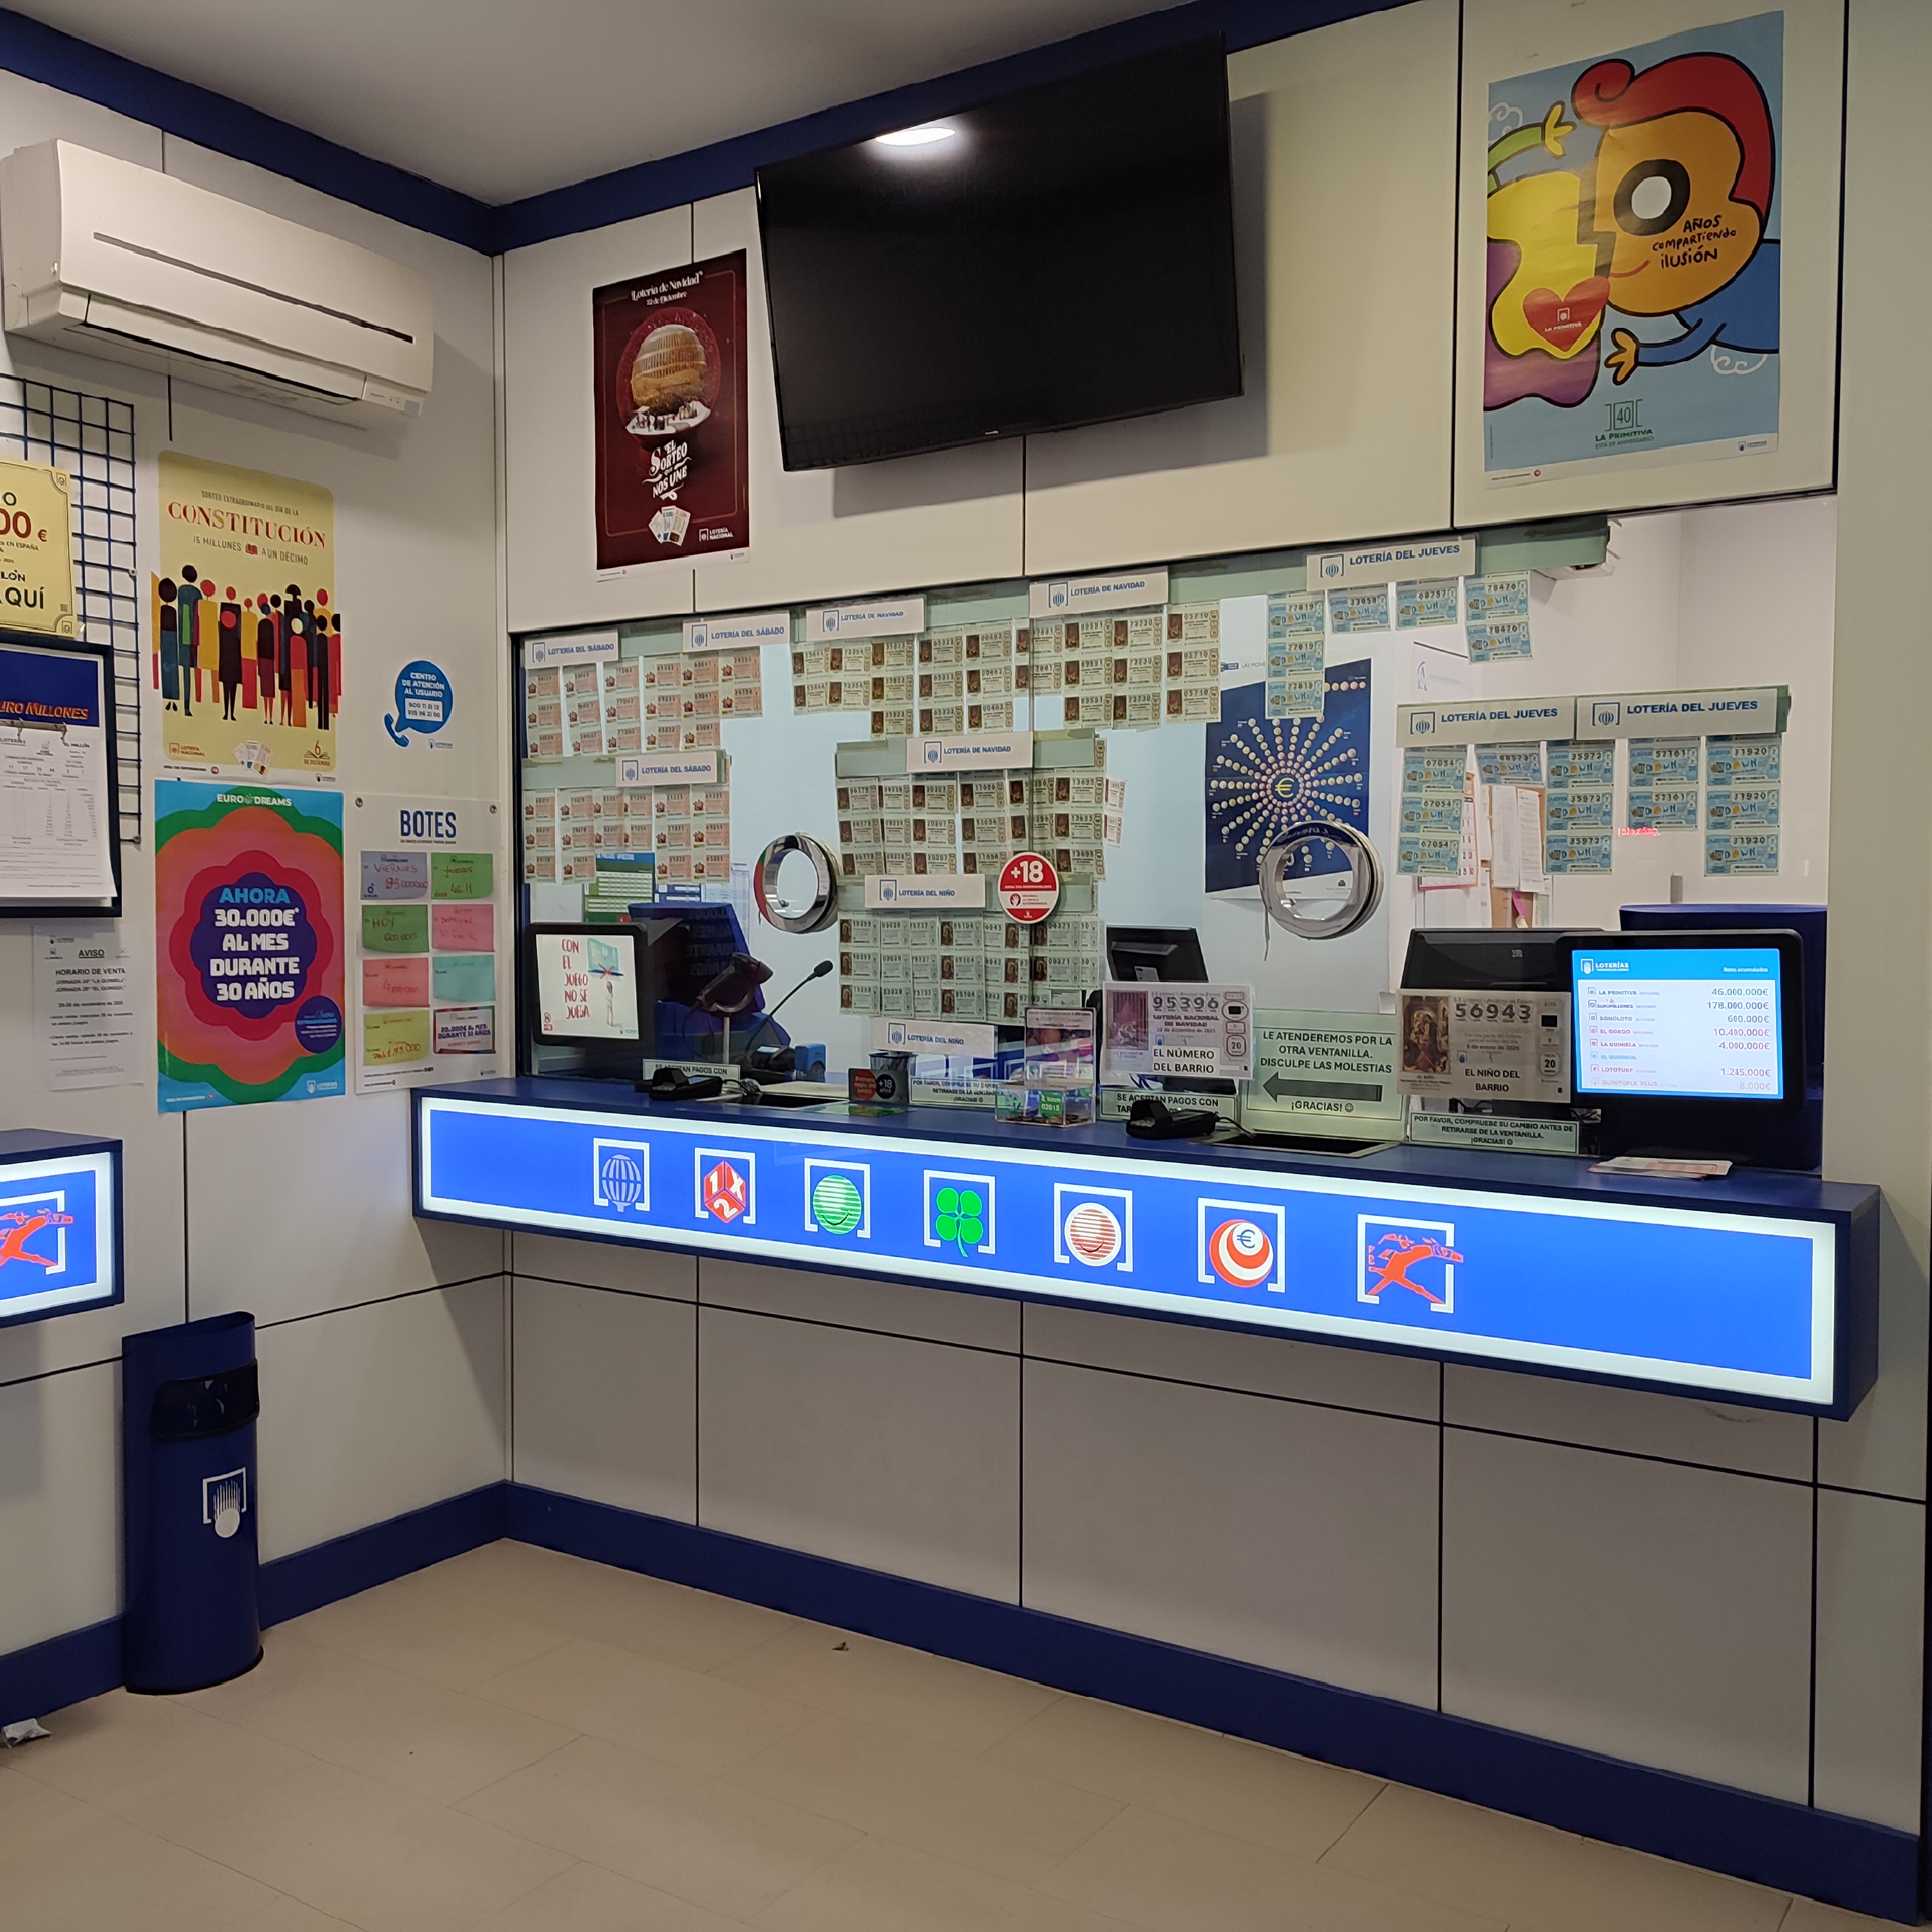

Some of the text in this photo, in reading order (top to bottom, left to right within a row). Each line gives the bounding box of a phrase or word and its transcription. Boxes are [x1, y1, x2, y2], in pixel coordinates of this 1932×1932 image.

[1616, 406, 1632, 424] 40
[1595, 428, 1654, 442] LA PRIMITIVA
[664, 440, 676, 453] EL
[649, 442, 688, 477] SORTEO
[653, 466, 688, 498] NOS UNE
[168, 502, 326, 548] CONSTITUCIÓN
[203, 537, 242, 551] MILLONES
[261, 547, 266, 556] A
[1349, 544, 1460, 565] LOTERÍA DEL JUEVES
[1070, 583, 1100, 596] LOTERÍA
[1113, 581, 1145, 591] NAVIDAD
[711, 629, 739, 639] LOTERÍA
[415, 688, 443, 697] USUARIO
[25, 701, 89, 720] MILLONES
[1627, 701, 1758, 714] LOTERÍA DEL JUEVES
[1441, 708, 1558, 723] LOTERÍA DEL JUEVES
[314, 740, 321, 755] 6
[943, 744, 971, 755] LOTERÍA
[982, 744, 1011, 753] NAVIDAD
[641, 765, 668, 774] LOTERÍA
[684, 764, 711, 772] SÁBADO
[216, 793, 292, 806] EURO DREAMS
[400, 810, 457, 838] BOTES
[1010, 860, 1043, 883] +18
[220, 887, 290, 904] AHORA
[898, 888, 923, 897] LOTERÍA
[938, 888, 955, 897] NIÑO
[223, 933, 289, 951] AL MES
[562, 939, 580, 953] CON
[79, 949, 105, 958] AVISO
[210, 957, 300, 976] DURANTE
[564, 972, 589, 986] JUEGO
[216, 977, 294, 1001] 30 AÑOS
[564, 989, 588, 1003] NO SE
[1153, 996, 1219, 1010] 95396
[1455, 1003, 1531, 1020] 56943
[907, 1034, 964, 1045] LOTERÍA DEL NIÑO
[1263, 1030, 1392, 1046] LE ATENDEREMOS POR LA
[1231, 1041, 1242, 1050] 20
[1279, 1045, 1373, 1059] OTRA VENTANILLA.
[1153, 1048, 1215, 1059] EL NÚMERO
[692, 1066, 712, 1074] PAGOS
[1153, 1063, 1214, 1074] DEL BARRIO
[1260, 1057, 1392, 1074] DISCULPE LAS MOLESTIAS
[1544, 1059, 1556, 1068] 20
[1465, 1067, 1520, 1079] EL NIÑO DEL
[878, 1079, 893, 1088] +18
[1475, 1083, 1510, 1092] BARRIO
[1168, 1096, 1197, 1106] PAGOS
[1198, 1098, 1218, 1106] CON
[1291, 1101, 1342, 1112] ¡GRACIAS!
[1441, 1126, 1478, 1135] RETIRARSE
[1454, 1119, 1497, 1128] COMPRUEBE
[1510, 1122, 1539, 1130] CAMBIO
